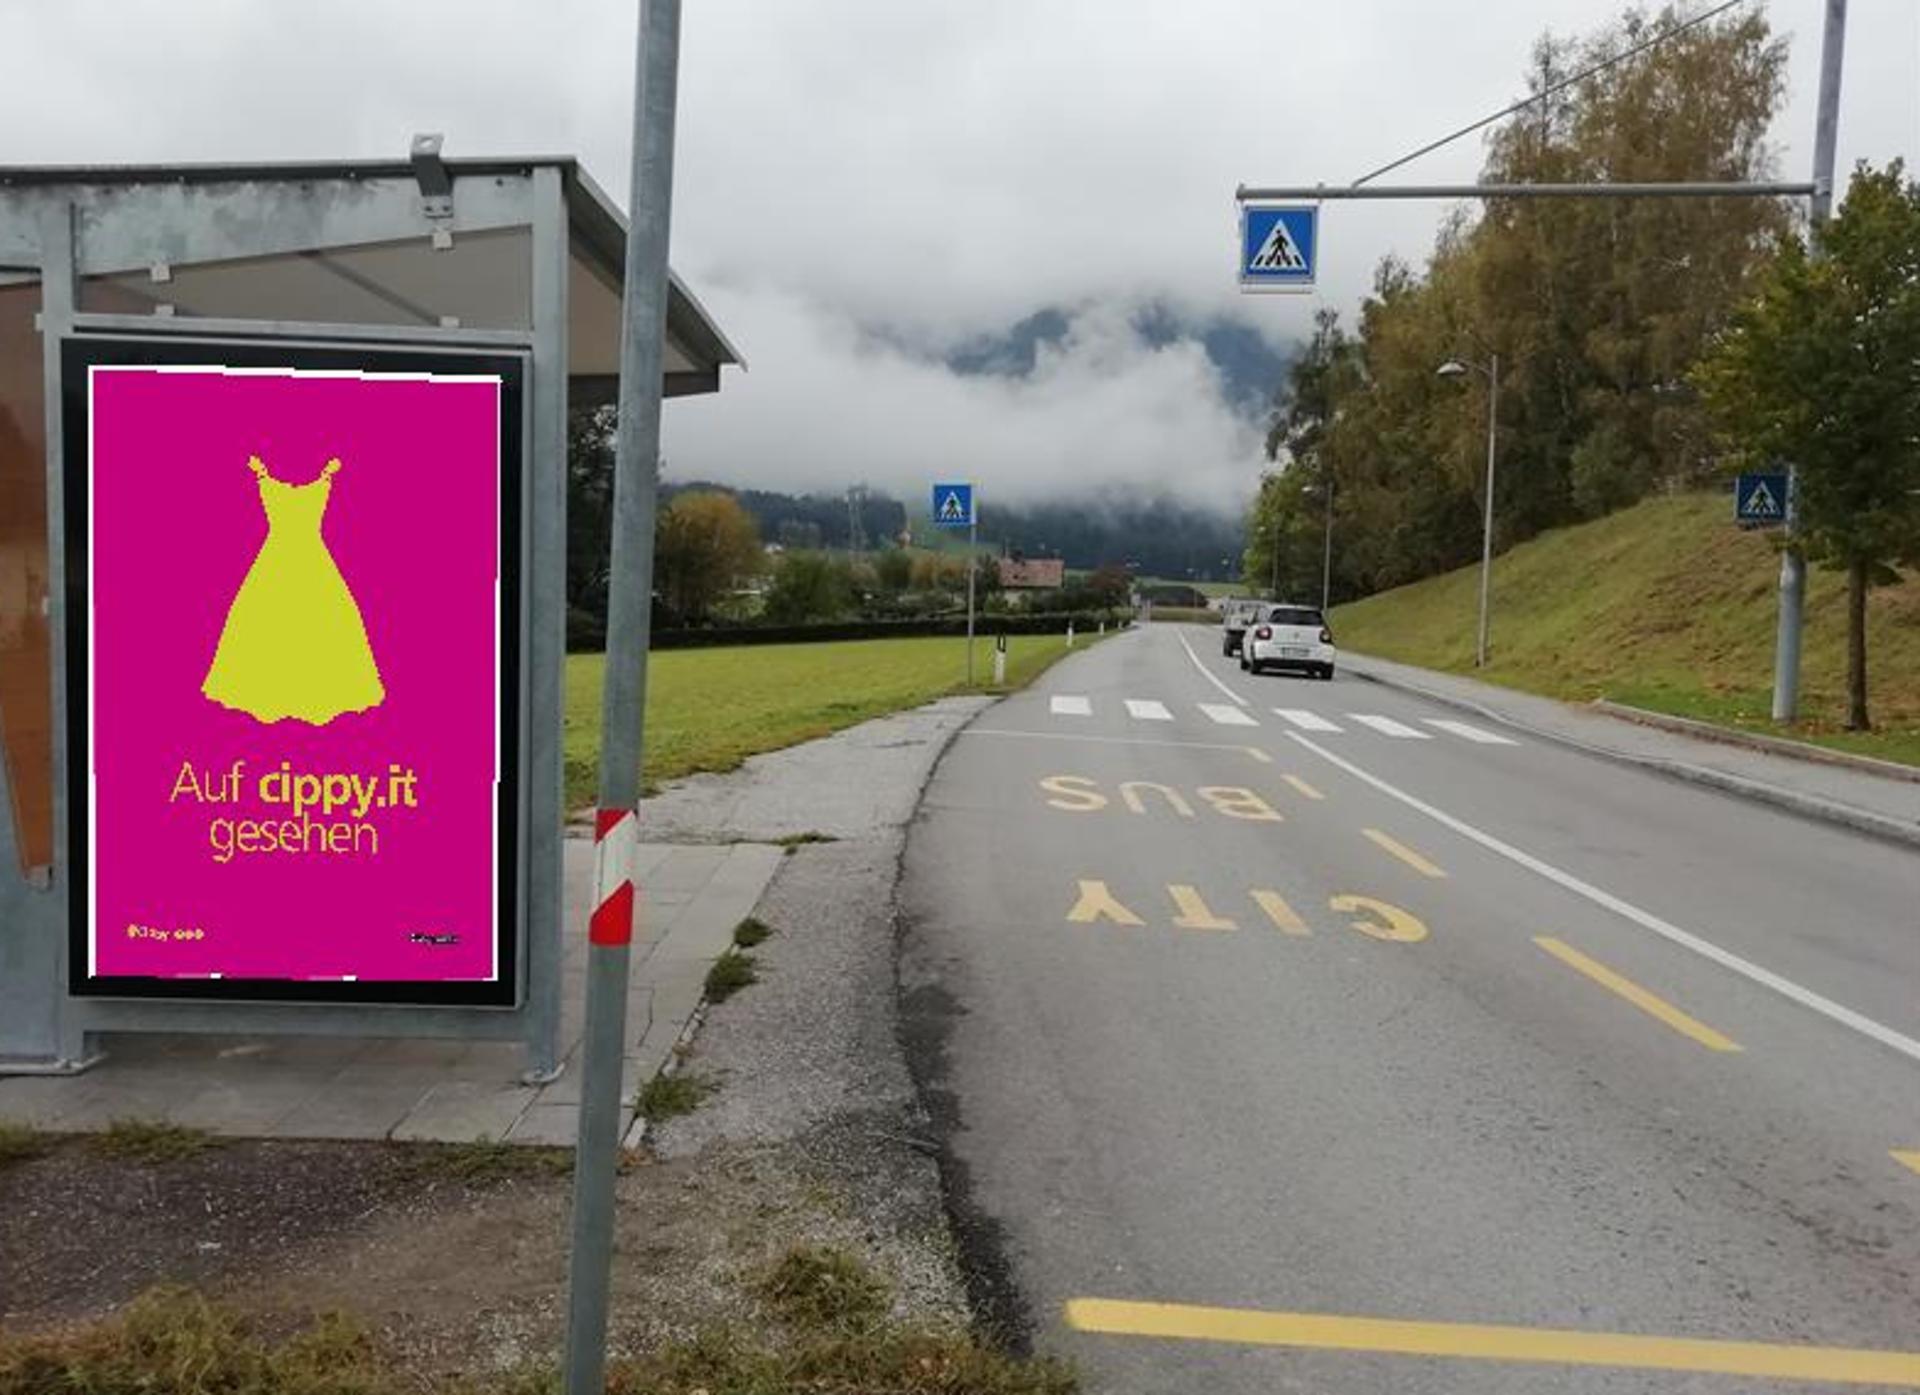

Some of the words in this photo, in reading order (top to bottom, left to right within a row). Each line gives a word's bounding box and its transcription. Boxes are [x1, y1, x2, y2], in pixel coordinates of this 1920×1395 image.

[170, 760, 245, 803] Auf
[259, 761, 418, 818] cippy.it
[1040, 775, 1284, 822] BUS
[210, 811, 379, 864] gesehen
[1066, 879, 1430, 942] CITY
